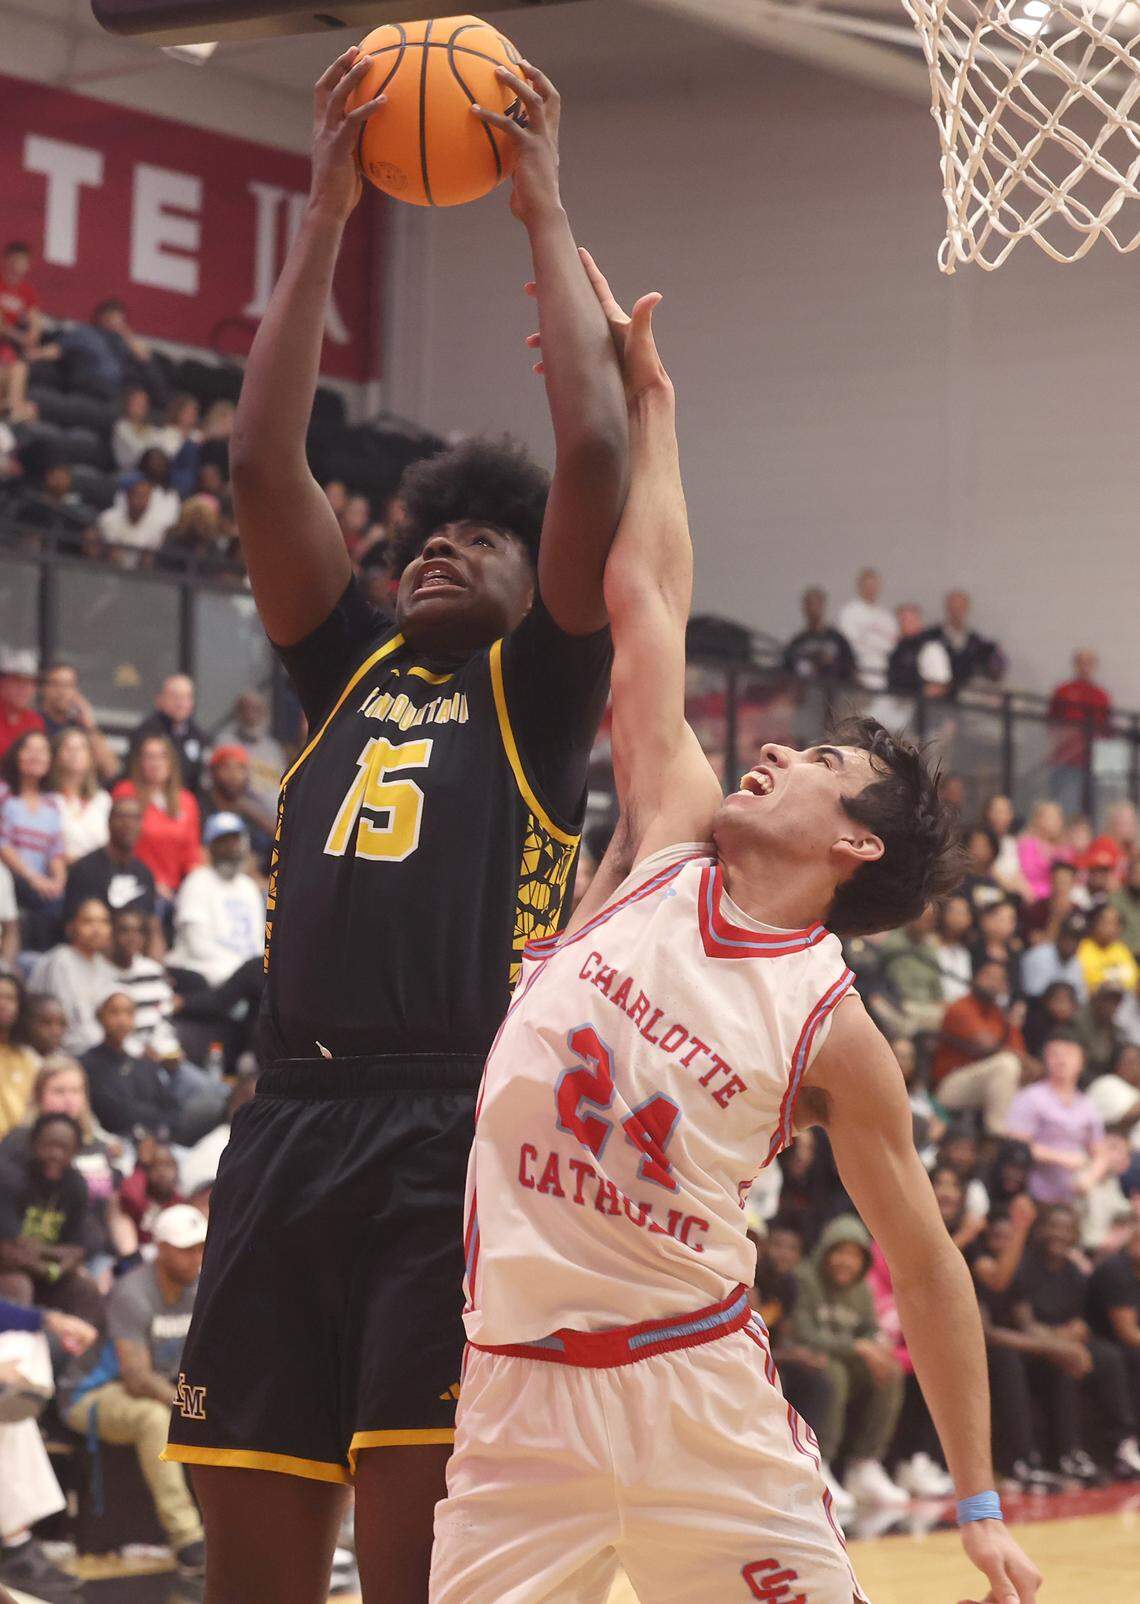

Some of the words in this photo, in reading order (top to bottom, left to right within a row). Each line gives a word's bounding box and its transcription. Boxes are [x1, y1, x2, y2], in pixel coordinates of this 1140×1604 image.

[323, 736, 434, 863] 15
[554, 1022, 682, 1194] 24
[578, 950, 748, 1110] CHARLOTTE
